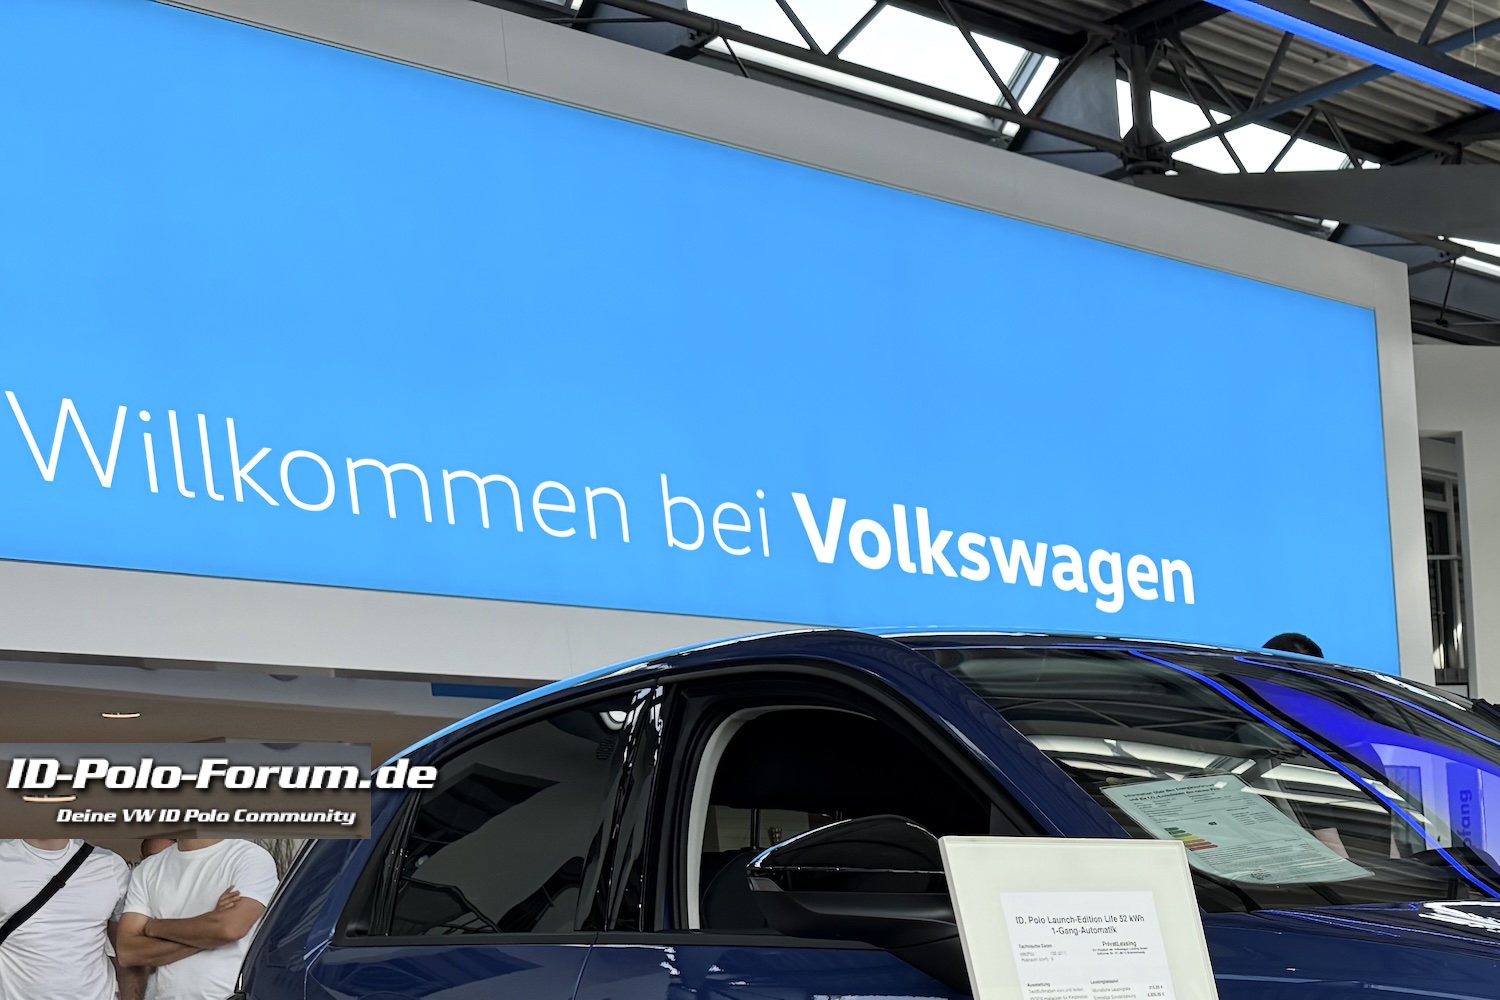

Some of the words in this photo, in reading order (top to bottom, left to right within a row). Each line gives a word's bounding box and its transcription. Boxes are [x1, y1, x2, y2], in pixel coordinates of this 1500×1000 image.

[5, 390, 630, 543] Willkommen
[661, 473, 770, 557] bei
[791, 491, 1195, 613] Volkswagen
[1028, 916, 1046, 924] Polo
[1047, 915, 1103, 924] Launch-Edition
[1104, 915, 1118, 923] Life
[1118, 915, 1128, 923] 52
[1128, 914, 1145, 922] kWh
[1051, 926, 1118, 936] 1-Gang-Automatik
